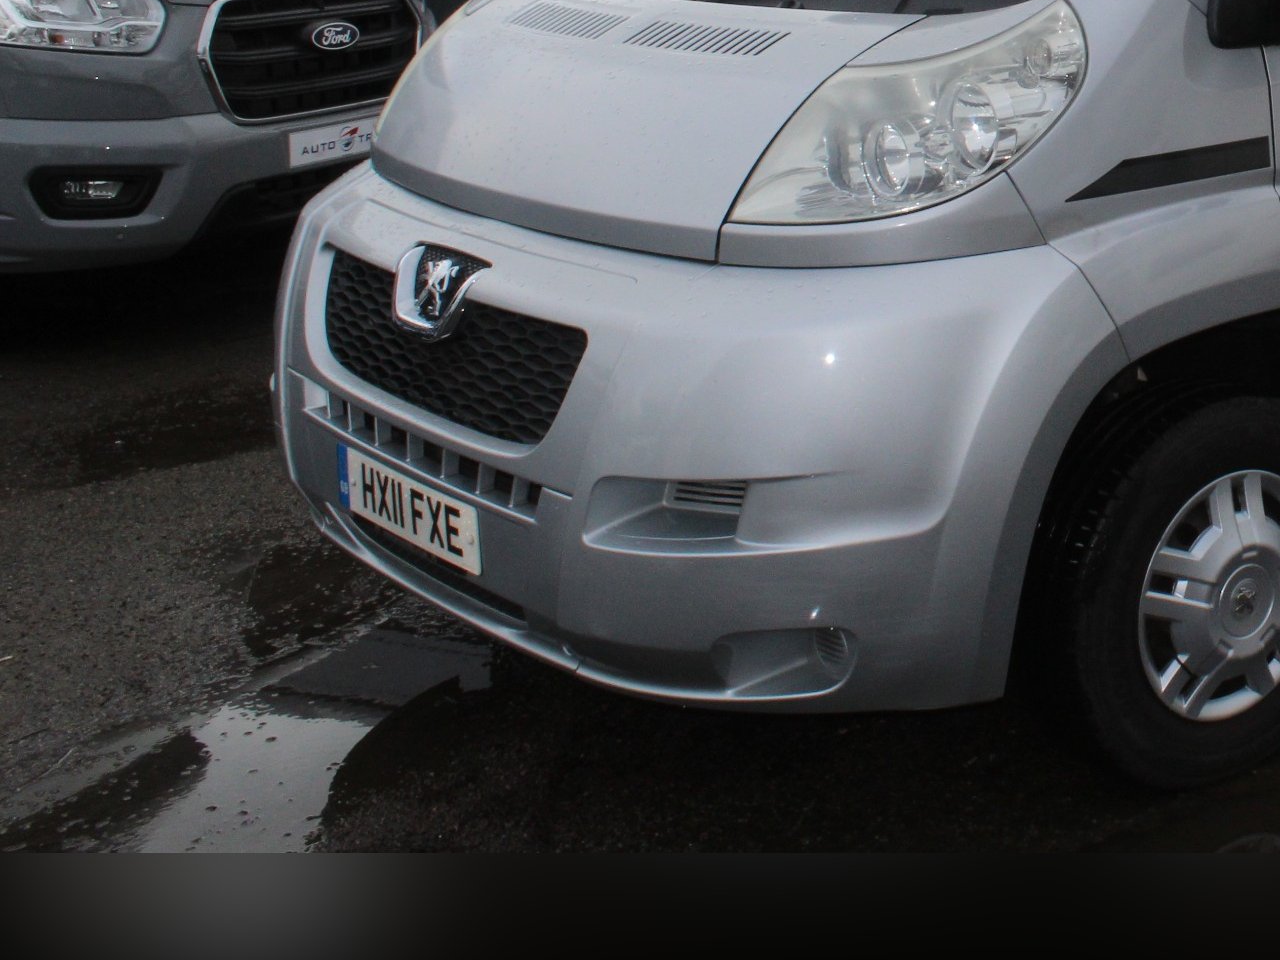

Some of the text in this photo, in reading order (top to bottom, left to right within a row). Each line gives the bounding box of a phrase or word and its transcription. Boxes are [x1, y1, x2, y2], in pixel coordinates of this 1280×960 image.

[322, 26, 351, 46] Ford
[301, 140, 336, 155] AUTO
[361, 462, 464, 558] HX11 FXE
